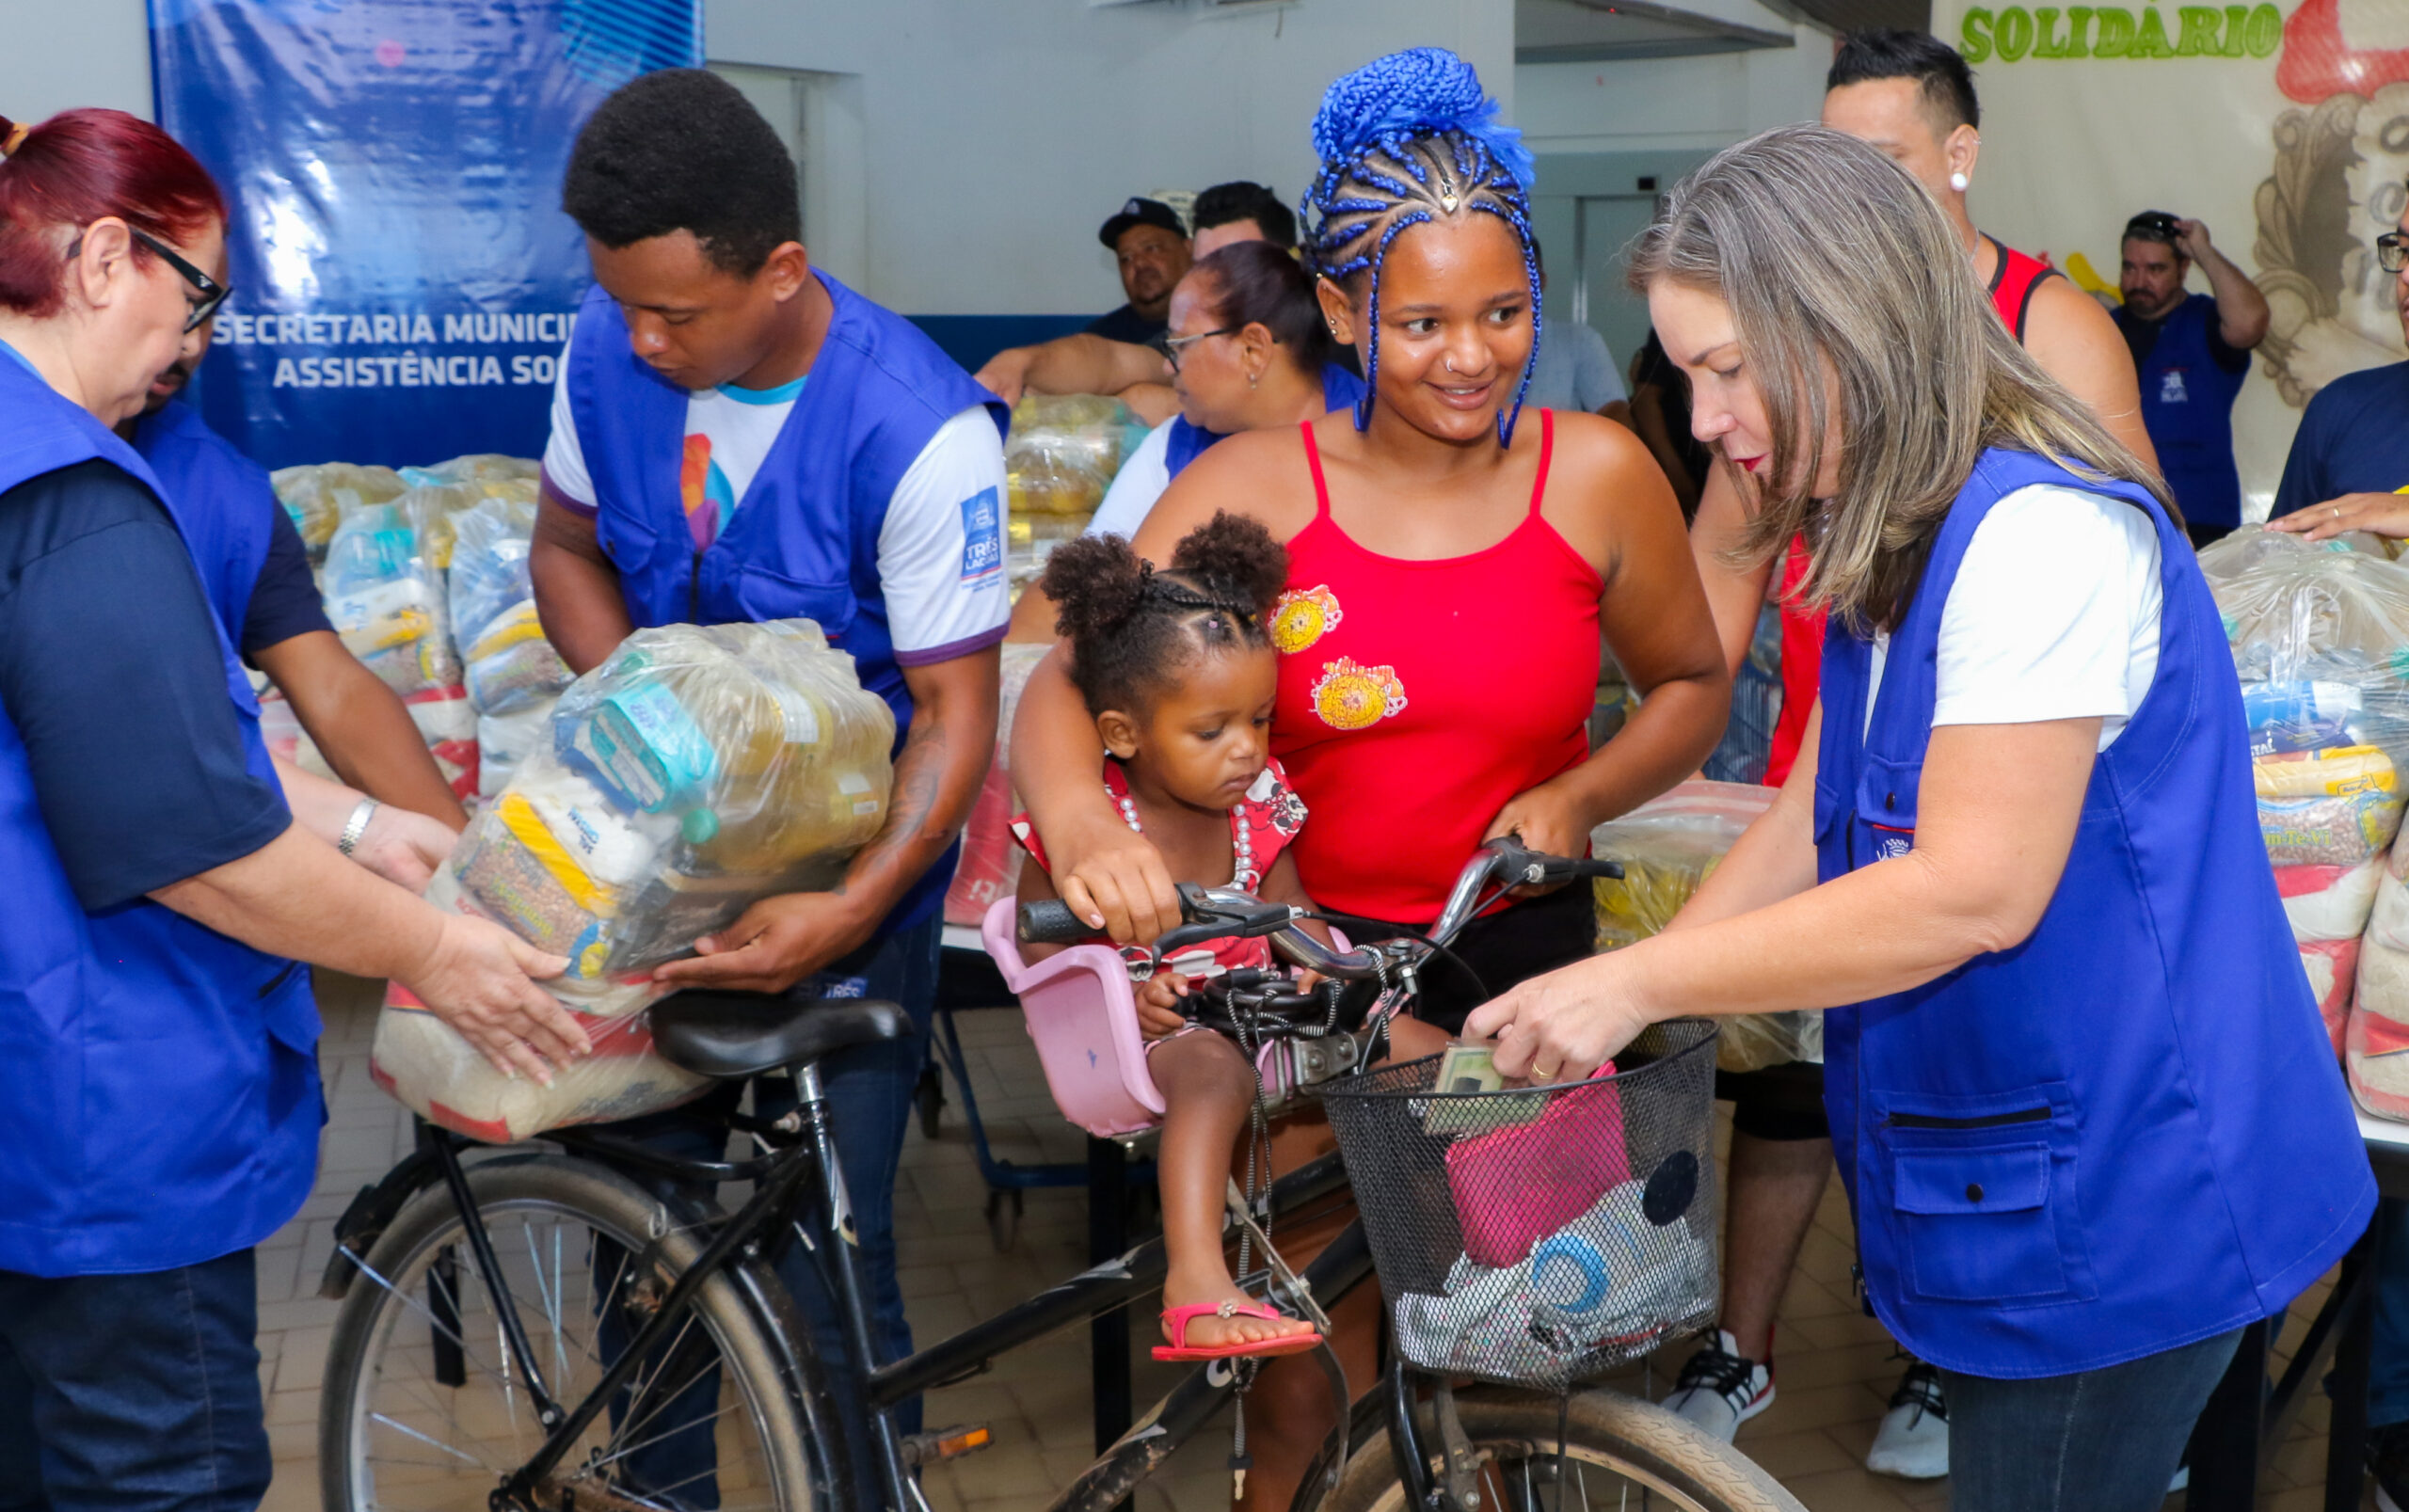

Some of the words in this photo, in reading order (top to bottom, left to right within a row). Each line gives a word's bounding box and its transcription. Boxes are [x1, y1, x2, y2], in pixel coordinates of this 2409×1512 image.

[211, 313, 437, 345] SECRETARIA
[273, 350, 505, 388] ASSISTÊNCIA
[511, 354, 562, 386] SO
